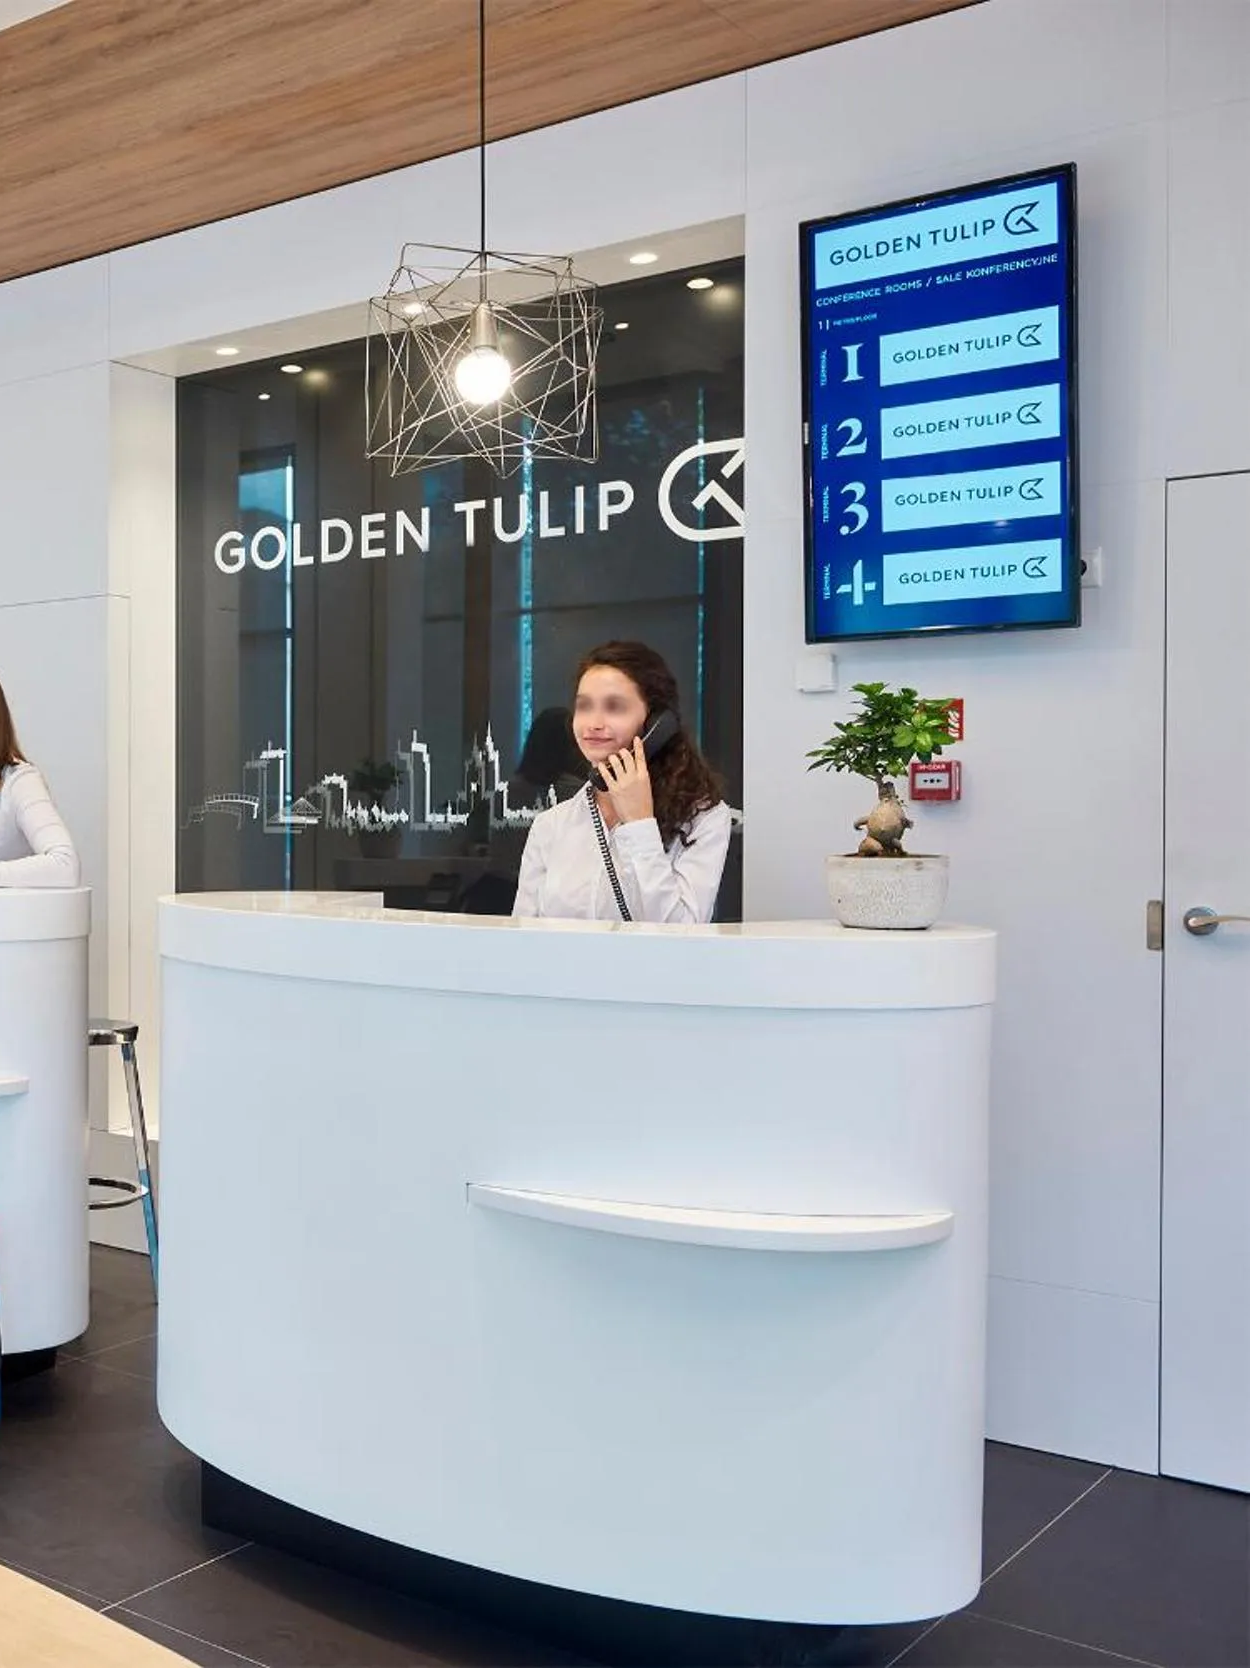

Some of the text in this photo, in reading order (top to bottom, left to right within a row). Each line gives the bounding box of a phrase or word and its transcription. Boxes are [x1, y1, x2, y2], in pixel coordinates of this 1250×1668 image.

[829, 218, 996, 266] GOLDEN TULIP
[816, 287, 881, 308] CONFERENCE
[885, 279, 923, 294] ROOMS
[936, 271, 962, 285] SALE
[966, 253, 1058, 279] KONFERENCYJNE
[892, 334, 1012, 364] GOLDEN TULIP
[836, 417, 868, 458] 2
[892, 411, 1012, 438] GOLDEN TULIP
[839, 481, 869, 535] 3
[894, 485, 1013, 506] GOLDEN TULIP
[214, 479, 635, 574] GOLDEN TULIP
[836, 559, 877, 606] 4
[899, 564, 1018, 585] GOLDEN TULIP
